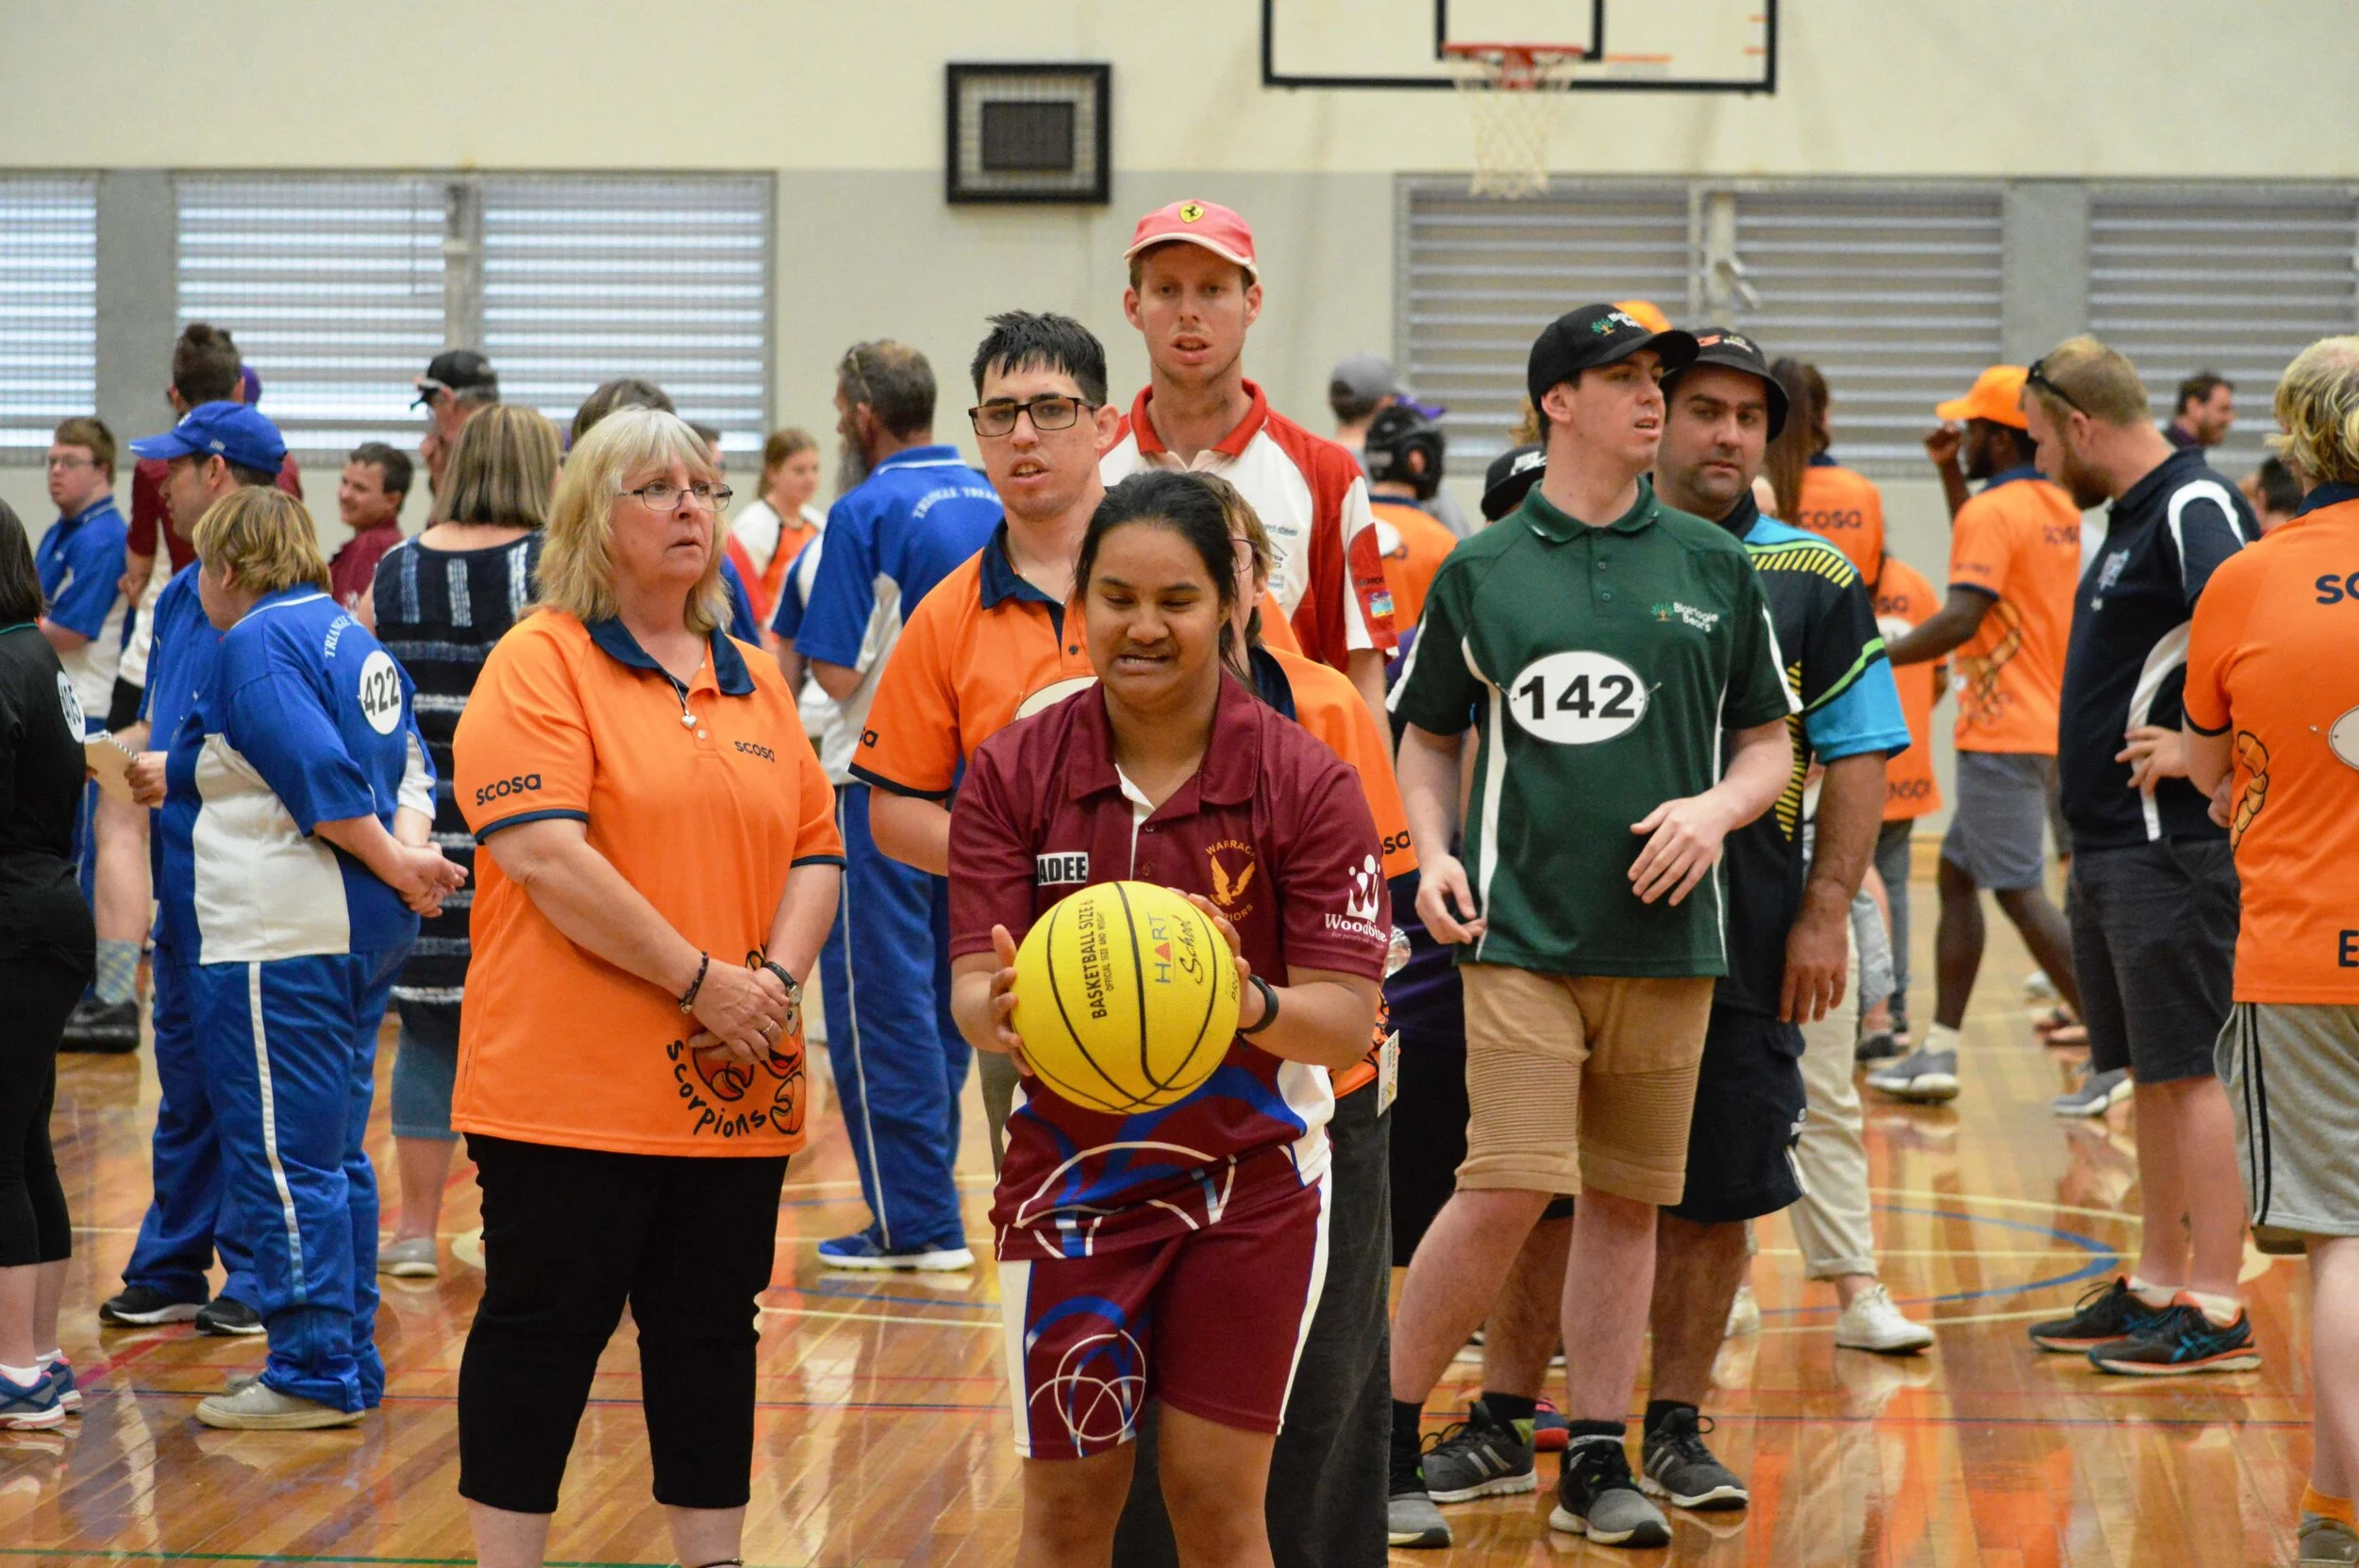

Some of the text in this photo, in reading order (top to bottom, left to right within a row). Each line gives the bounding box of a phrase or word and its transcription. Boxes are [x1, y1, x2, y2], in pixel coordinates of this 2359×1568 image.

[363, 665, 400, 716] 422
[1519, 674, 1635, 720] 142
[734, 741, 775, 762] scosa
[476, 774, 542, 807] scosa
[1381, 830, 1411, 855] sa
[1039, 856, 1087, 883] ADEE
[1079, 905, 1095, 931] SIZE
[1098, 933, 1108, 945] AND
[1147, 912, 1172, 984] HART
[1172, 915, 1204, 985] School
[1099, 948, 1110, 961] SIZE
[1080, 931, 1108, 1020] BASKETBALL
[1101, 963, 1114, 993] OFFICIAL
